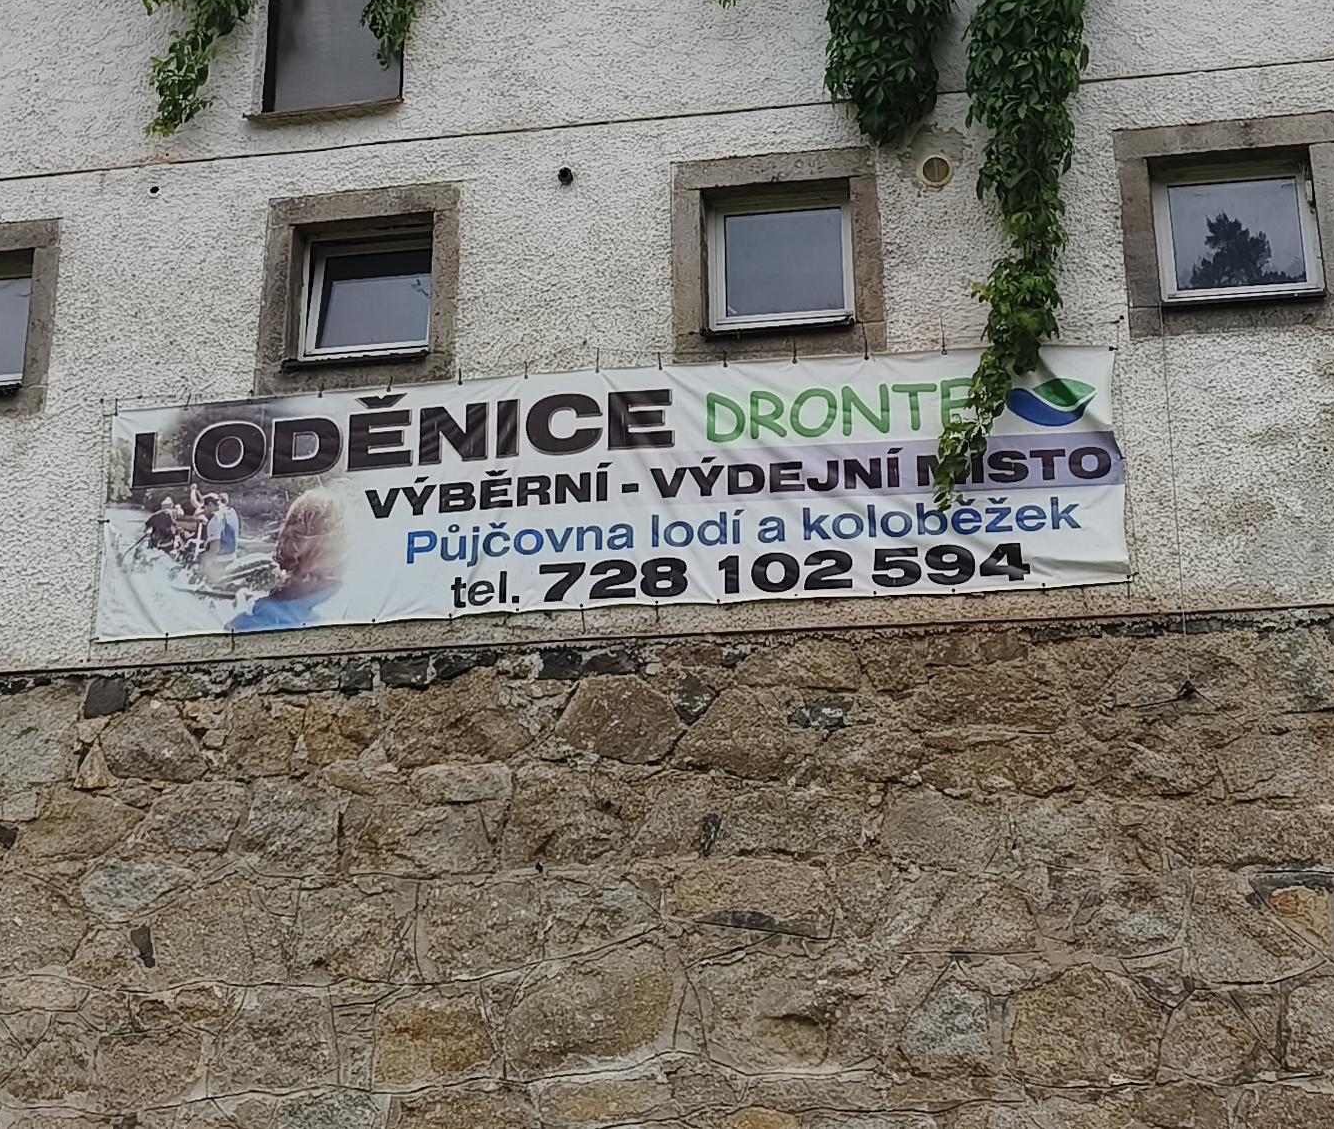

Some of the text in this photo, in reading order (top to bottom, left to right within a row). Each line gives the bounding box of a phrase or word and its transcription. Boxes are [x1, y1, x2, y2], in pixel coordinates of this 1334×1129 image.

[130, 389, 675, 489] LODĚNICE
[365, 461, 612, 519] VÝBĚRNÍ
[650, 447, 903, 498] VÝDEJNÍ
[406, 496, 1082, 567] Půjčovna lodí a koloběžek
[451, 542, 1031, 609] tel. 728 102 594
